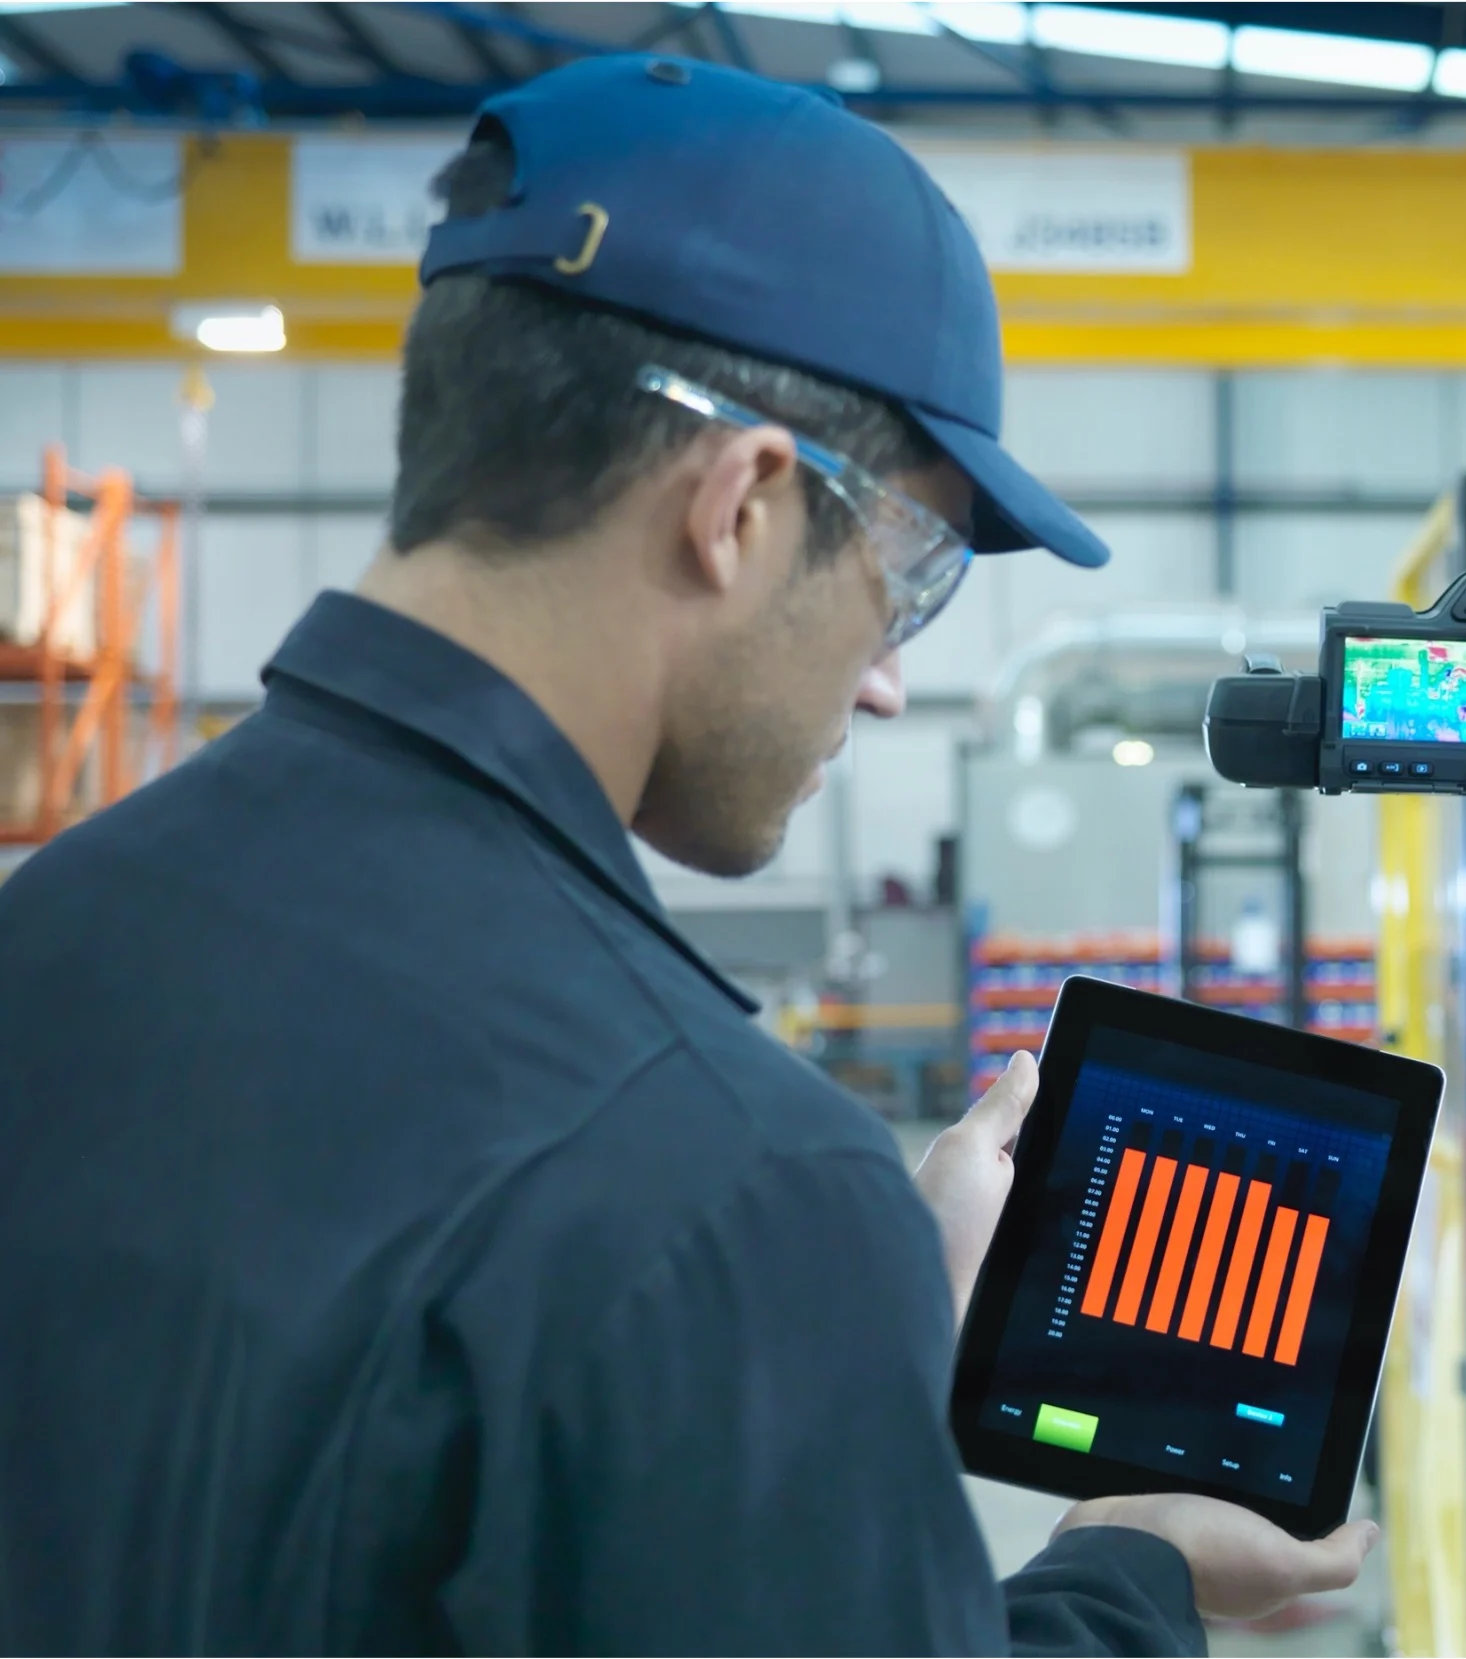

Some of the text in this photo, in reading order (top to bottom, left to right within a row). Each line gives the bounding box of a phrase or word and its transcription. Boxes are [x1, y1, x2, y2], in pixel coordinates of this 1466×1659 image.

[1140, 1107, 1154, 1116] MON
[1173, 1115, 1184, 1123] TUE
[1203, 1123, 1216, 1131] WED
[1235, 1131, 1247, 1139] THU
[1327, 1155, 1340, 1163] SUN
[1000, 1403, 1023, 1416] Energy
[1165, 1444, 1185, 1456] Power
[1222, 1458, 1240, 1470] Setup
[1279, 1472, 1293, 1482] Info
